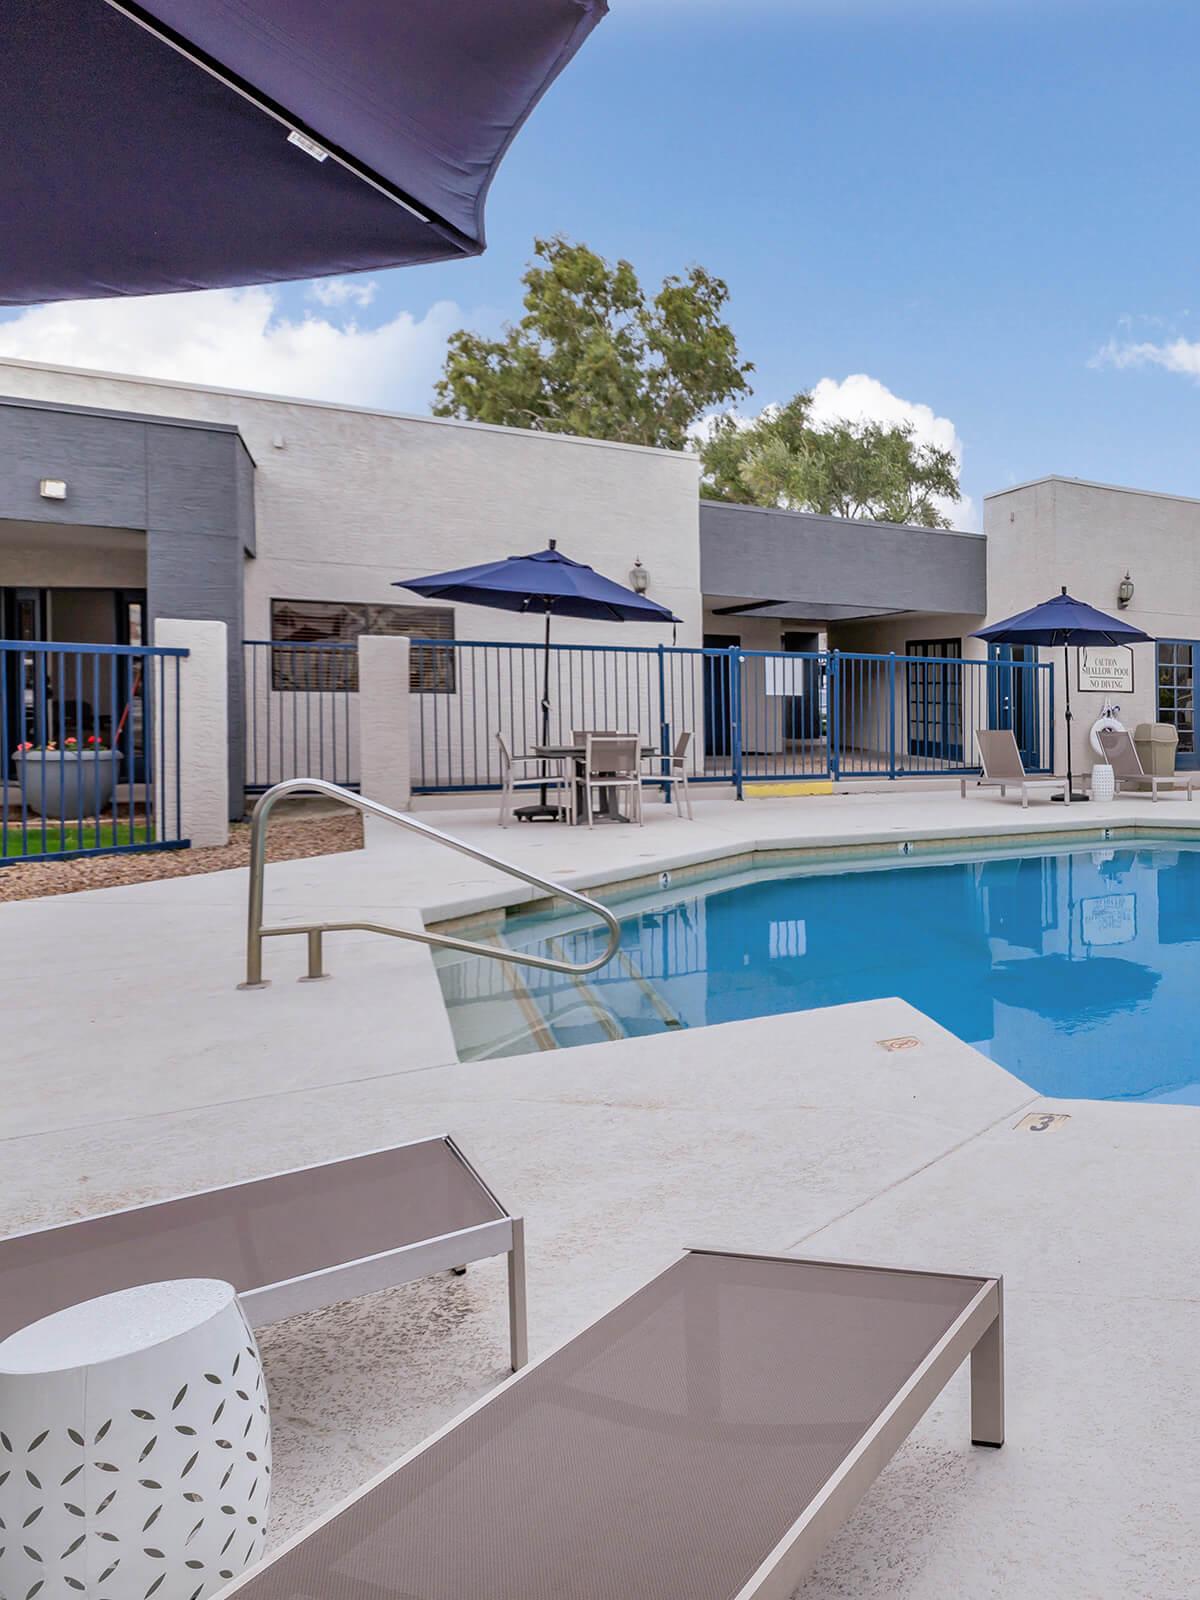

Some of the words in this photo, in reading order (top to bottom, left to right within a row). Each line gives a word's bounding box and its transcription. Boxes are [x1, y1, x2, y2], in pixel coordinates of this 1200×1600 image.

[1095, 658, 1117, 667] CAUTION
[1082, 667, 1112, 675] SHALLOW
[1113, 668, 1129, 676] POOL
[1090, 680, 1099, 688] NO
[1101, 680, 1123, 689] DIVING
[1030, 1115, 1055, 1131] 3
